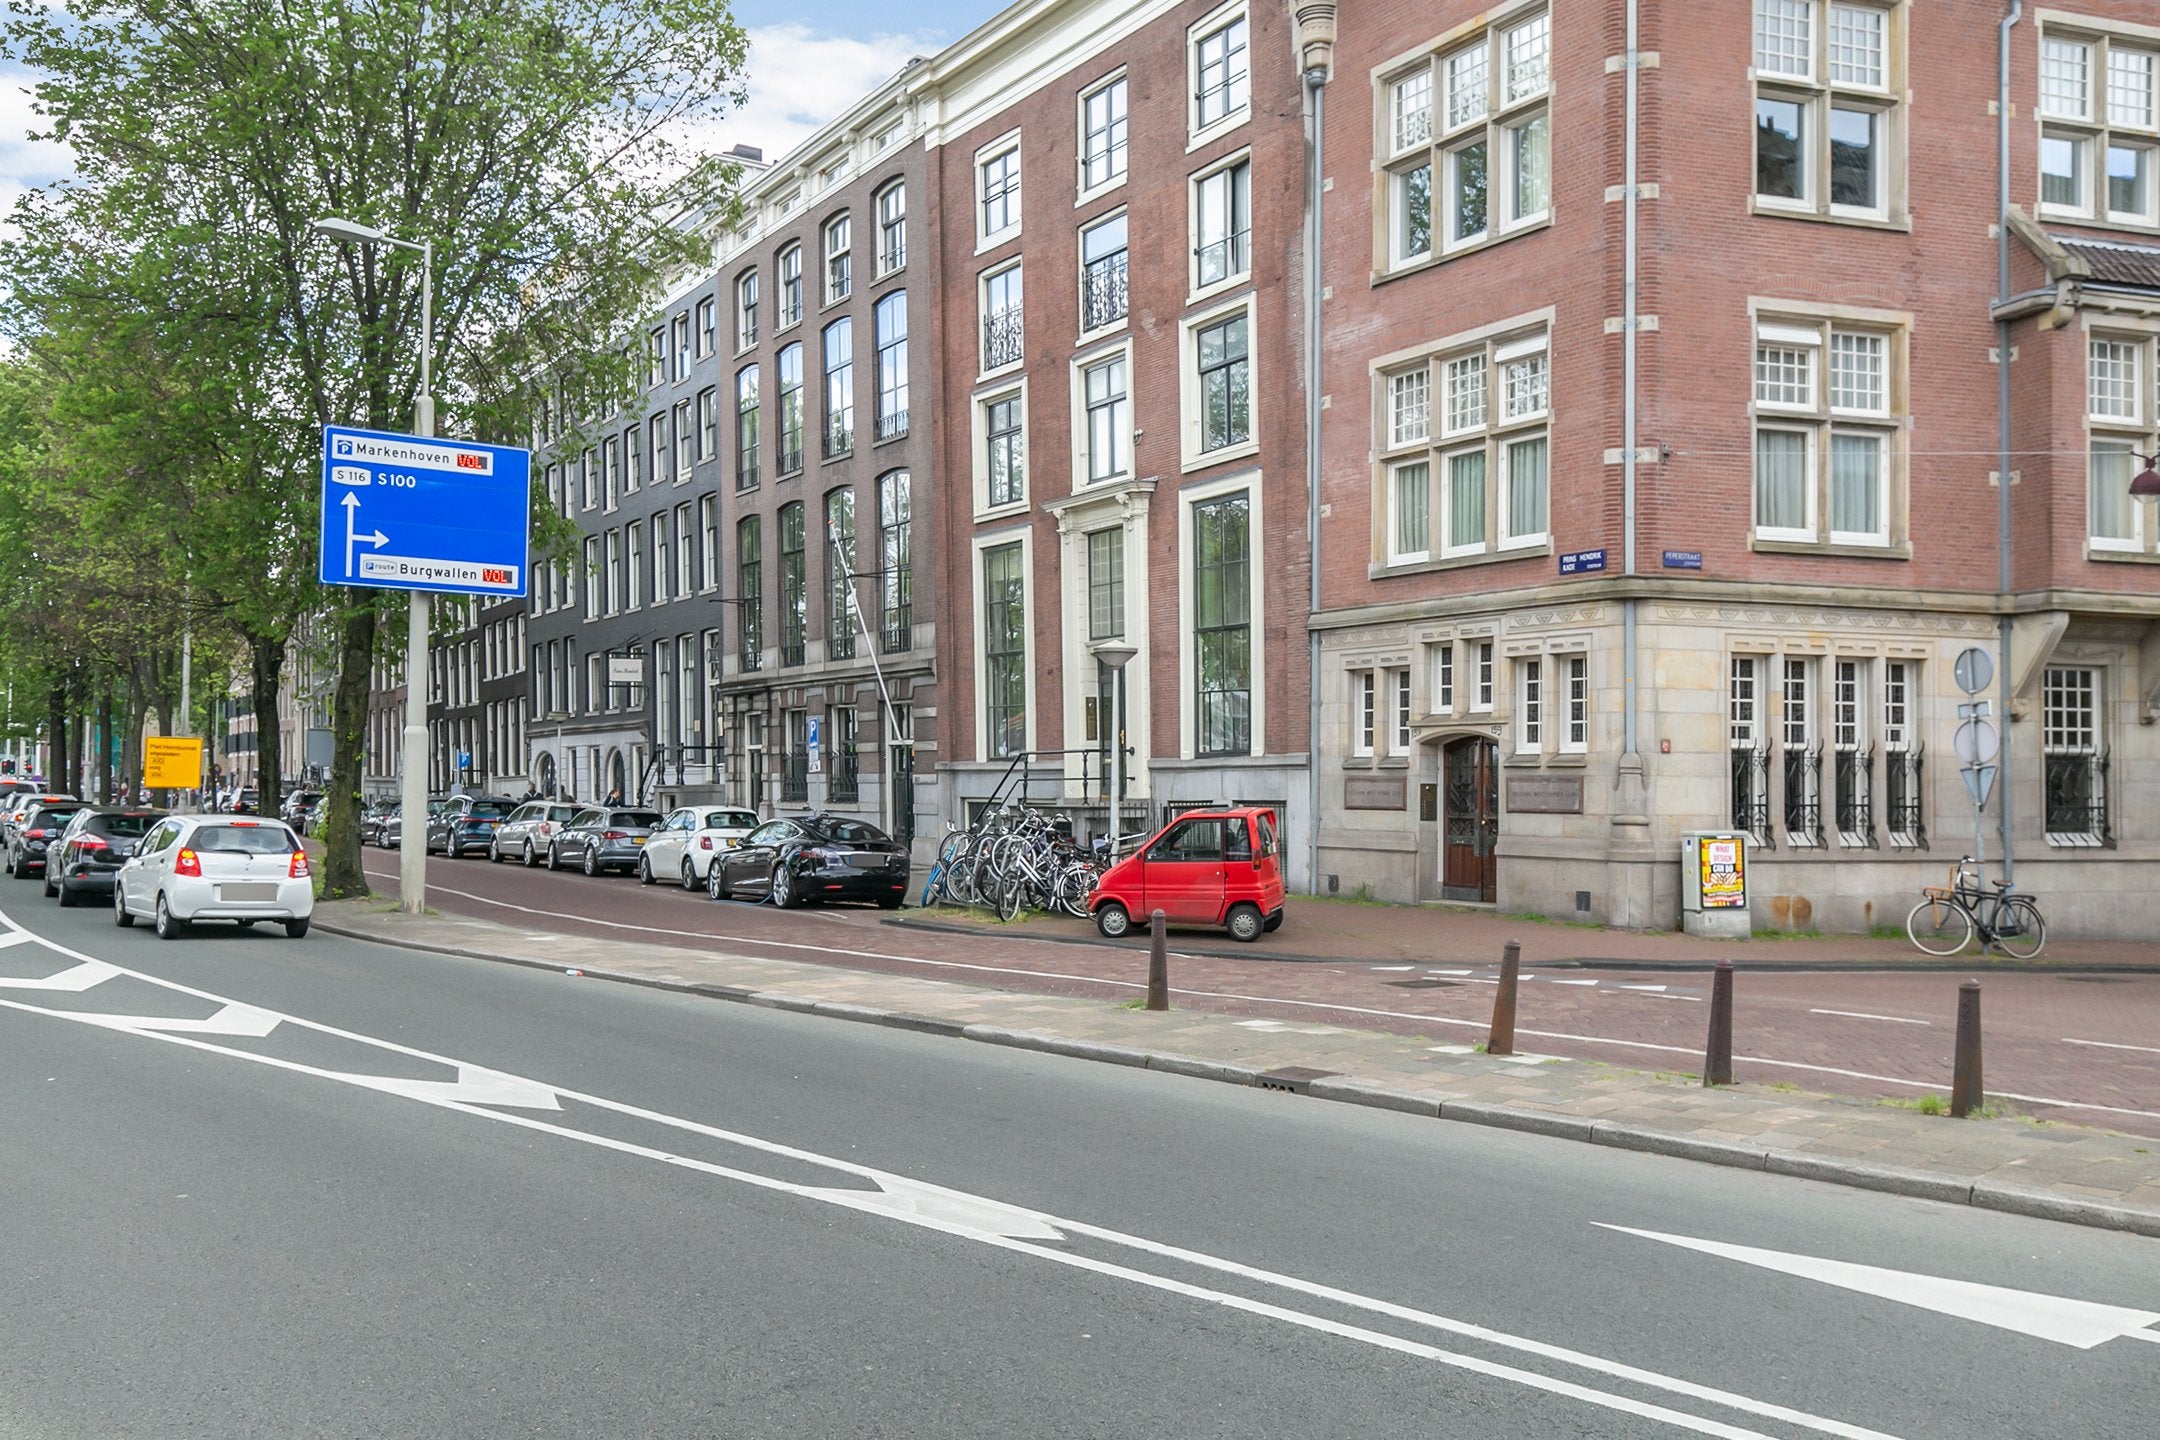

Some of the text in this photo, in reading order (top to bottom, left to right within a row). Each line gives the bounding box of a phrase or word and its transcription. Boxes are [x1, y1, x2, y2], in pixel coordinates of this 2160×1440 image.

[356, 444, 450, 464] Markenhoven
[457, 453, 482, 469] VOL
[374, 563, 395, 571] route
[400, 563, 477, 579] Burgwallen
[483, 568, 508, 583] VOL
[1491, 725, 1503, 736] 159
[1712, 864, 1734, 873] CAN DO
